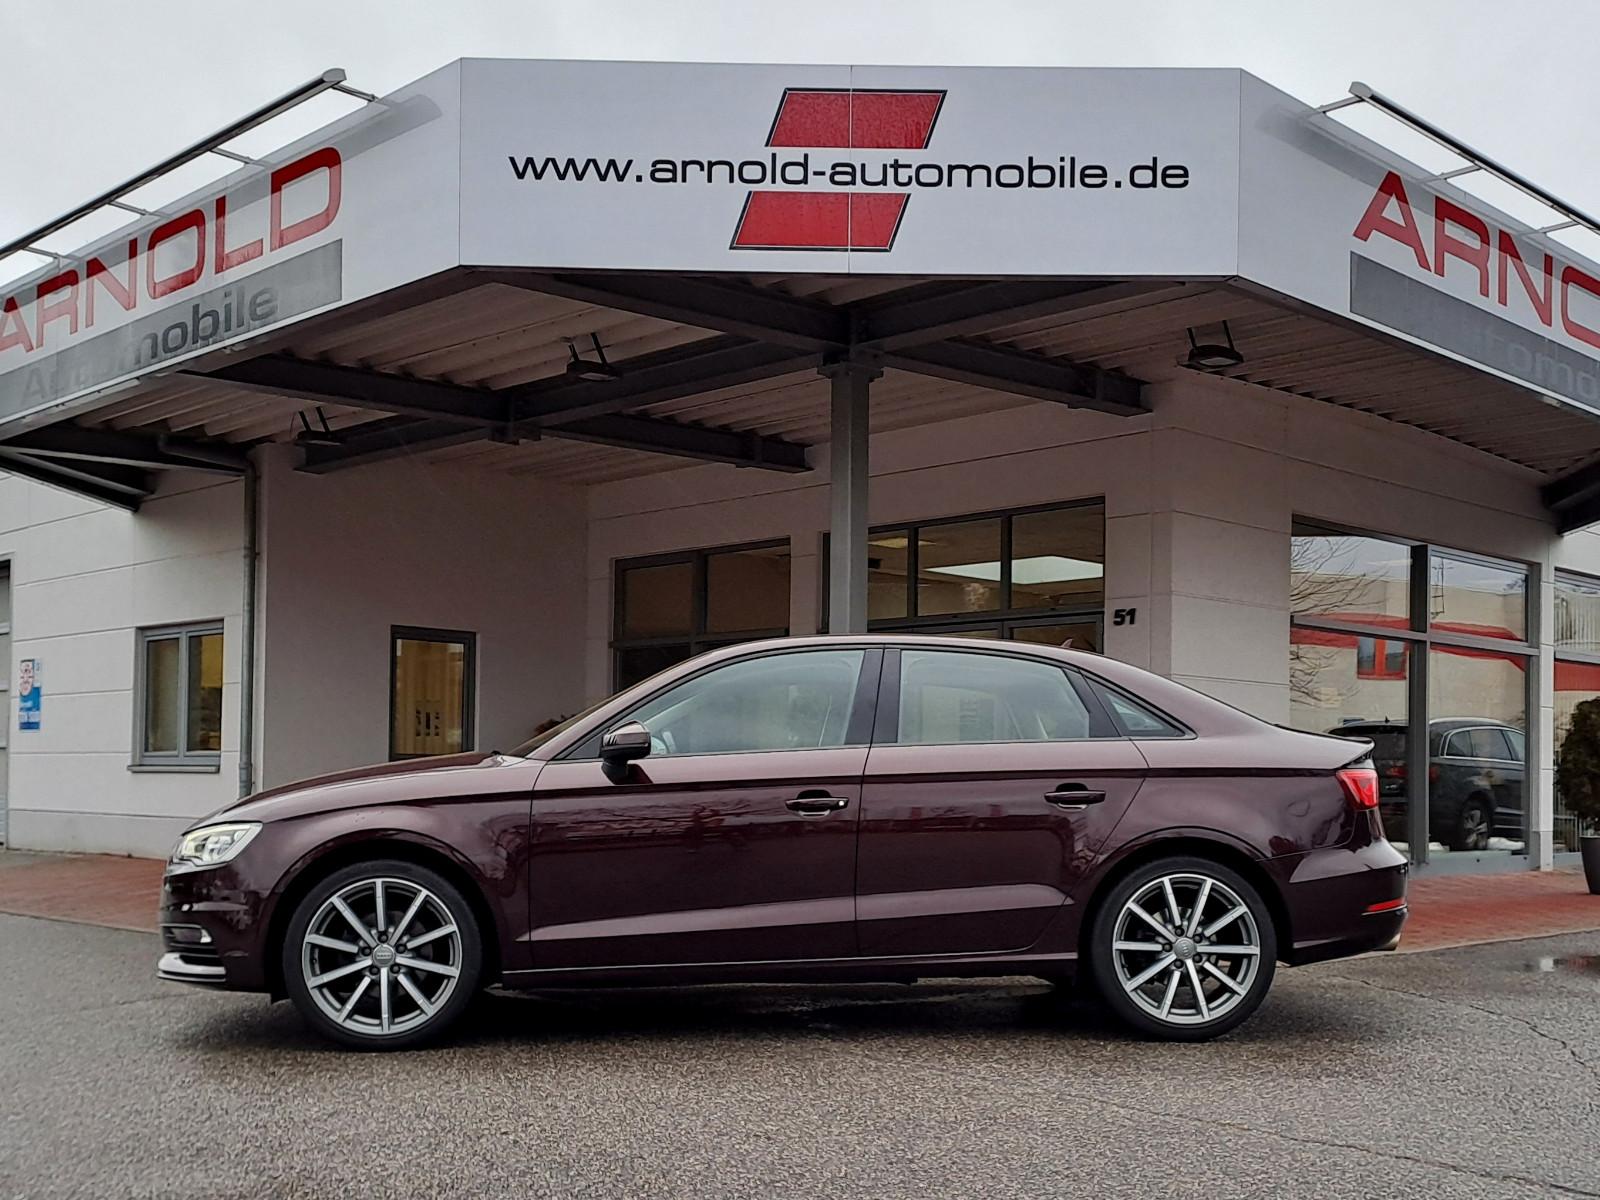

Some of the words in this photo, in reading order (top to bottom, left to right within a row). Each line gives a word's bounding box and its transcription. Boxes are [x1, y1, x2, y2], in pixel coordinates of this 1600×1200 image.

[508, 152, 1190, 189] www.arnold-automobile.de
[0, 146, 342, 352] ARNOLD
[1112, 607, 1137, 626] 51
